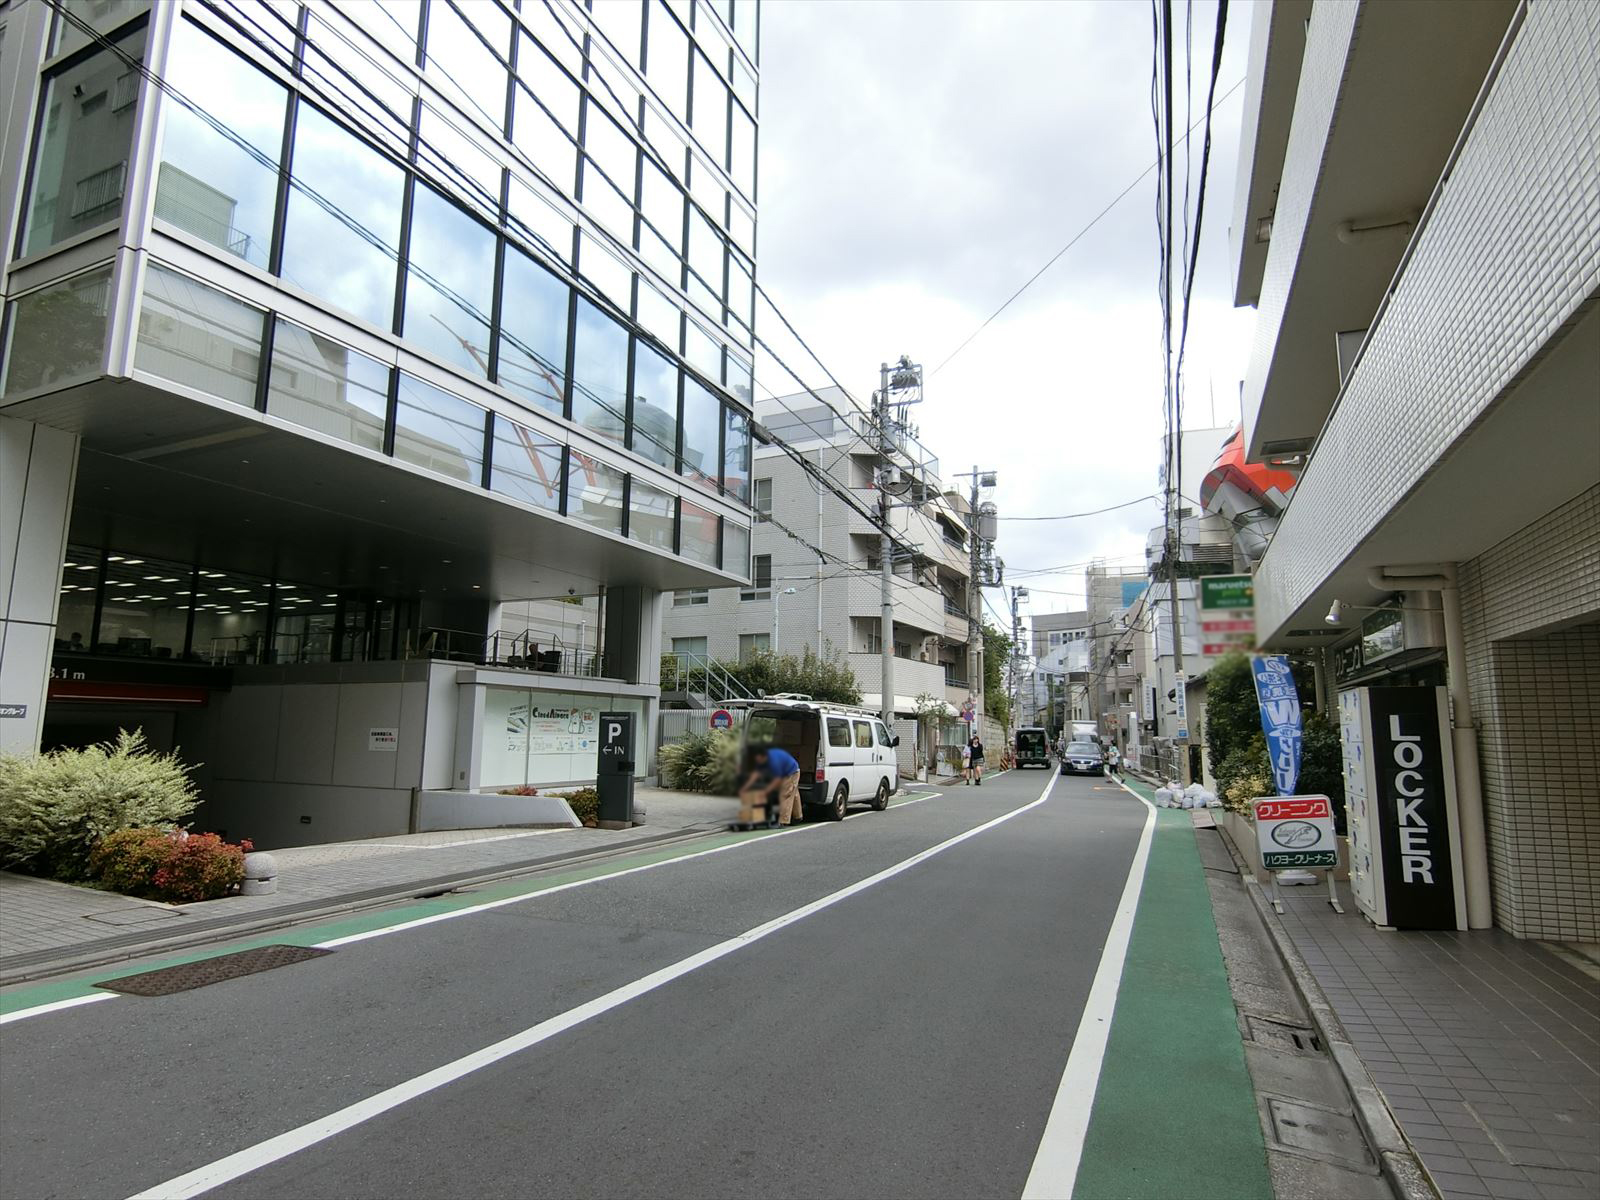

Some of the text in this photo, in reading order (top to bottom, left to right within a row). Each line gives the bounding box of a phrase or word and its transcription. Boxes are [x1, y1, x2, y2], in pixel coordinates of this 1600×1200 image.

[73, 671, 86, 680] m
[608, 723, 622, 744] P
[614, 745, 625, 755] IN
[1389, 714, 1434, 884] LOCKER
[1259, 802, 1328, 817] クリーニング
[1266, 853, 1336, 866] ハクヨークリーナース
